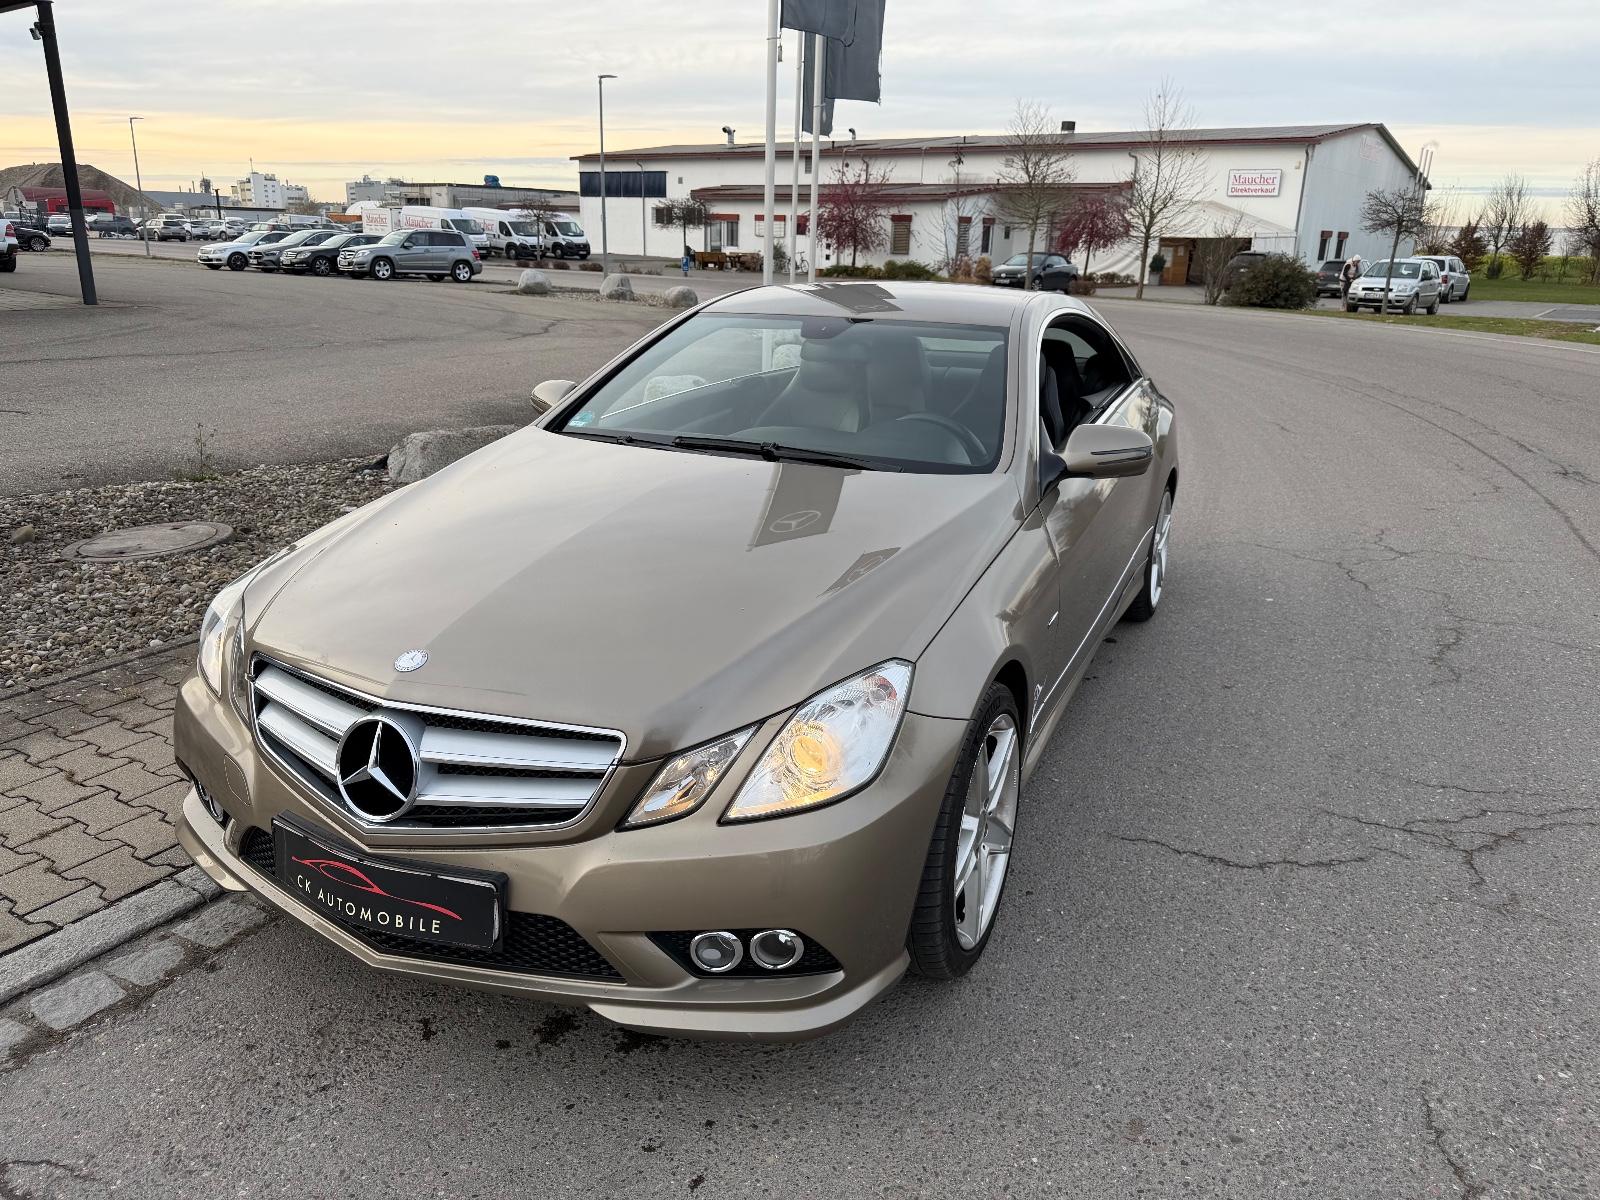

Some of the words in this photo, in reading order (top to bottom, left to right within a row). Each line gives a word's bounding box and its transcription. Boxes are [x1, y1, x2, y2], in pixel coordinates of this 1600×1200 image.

[1232, 174, 1277, 184] Maucher
[404, 215, 433, 228] Maucher
[297, 874, 311, 894] CK
[317, 890, 441, 934] AUTOMOBILE
